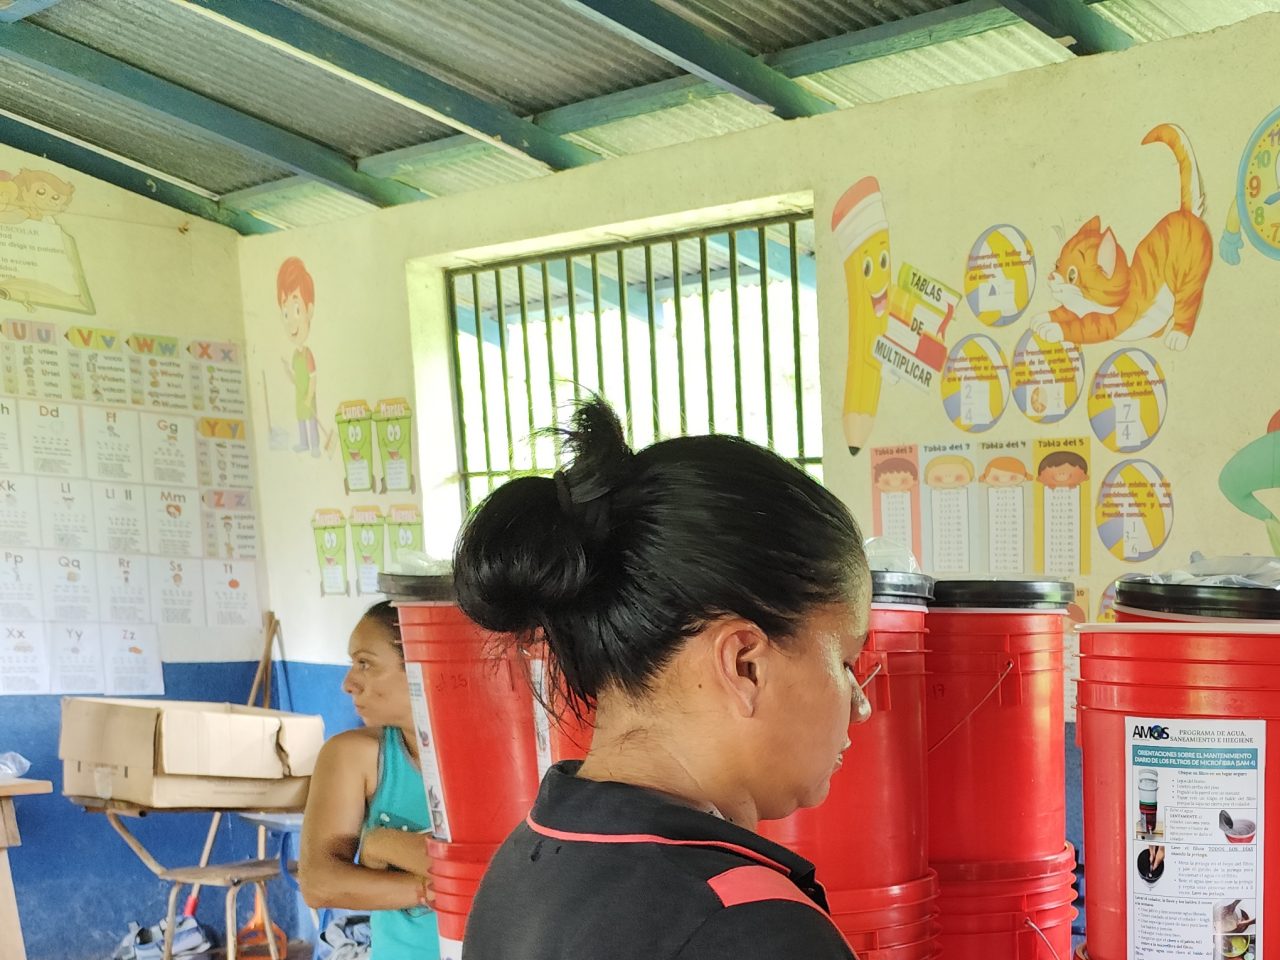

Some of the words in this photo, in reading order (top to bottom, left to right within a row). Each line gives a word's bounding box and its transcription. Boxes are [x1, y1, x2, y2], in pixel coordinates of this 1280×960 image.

[1255, 149, 1271, 168] 10
[1249, 175, 1261, 198] 9
[1255, 206, 1265, 226] 8
[1270, 223, 1280, 242] 7
[910, 272, 943, 303] TABLAS
[12, 322, 27, 340] U
[910, 318, 925, 337] DE
[76, 329, 93, 347] V
[134, 336, 156, 353] W
[198, 342, 213, 360] X
[874, 339, 933, 388] MULTIPLICAR
[39, 405, 59, 418] Dd
[1123, 404, 1131, 420] 7
[157, 419, 178, 434] Gg
[205, 420, 219, 437] Y
[1122, 424, 1131, 440] 4
[895, 447, 907, 455] del
[923, 444, 947, 452] Tabla
[949, 443, 963, 451] del
[981, 441, 1004, 450] Tabla
[1006, 440, 1019, 449] del
[1038, 440, 1060, 448] Tabla
[1062, 438, 1077, 447] del
[1079, 438, 1084, 446] 5
[160, 491, 186, 503] Mm
[213, 491, 225, 508] Z
[4, 551, 24, 566] Pp
[58, 556, 81, 570] Qq
[1132, 725, 1169, 740] AMOS
[1137, 749, 1177, 757] ORIENTACIONES
